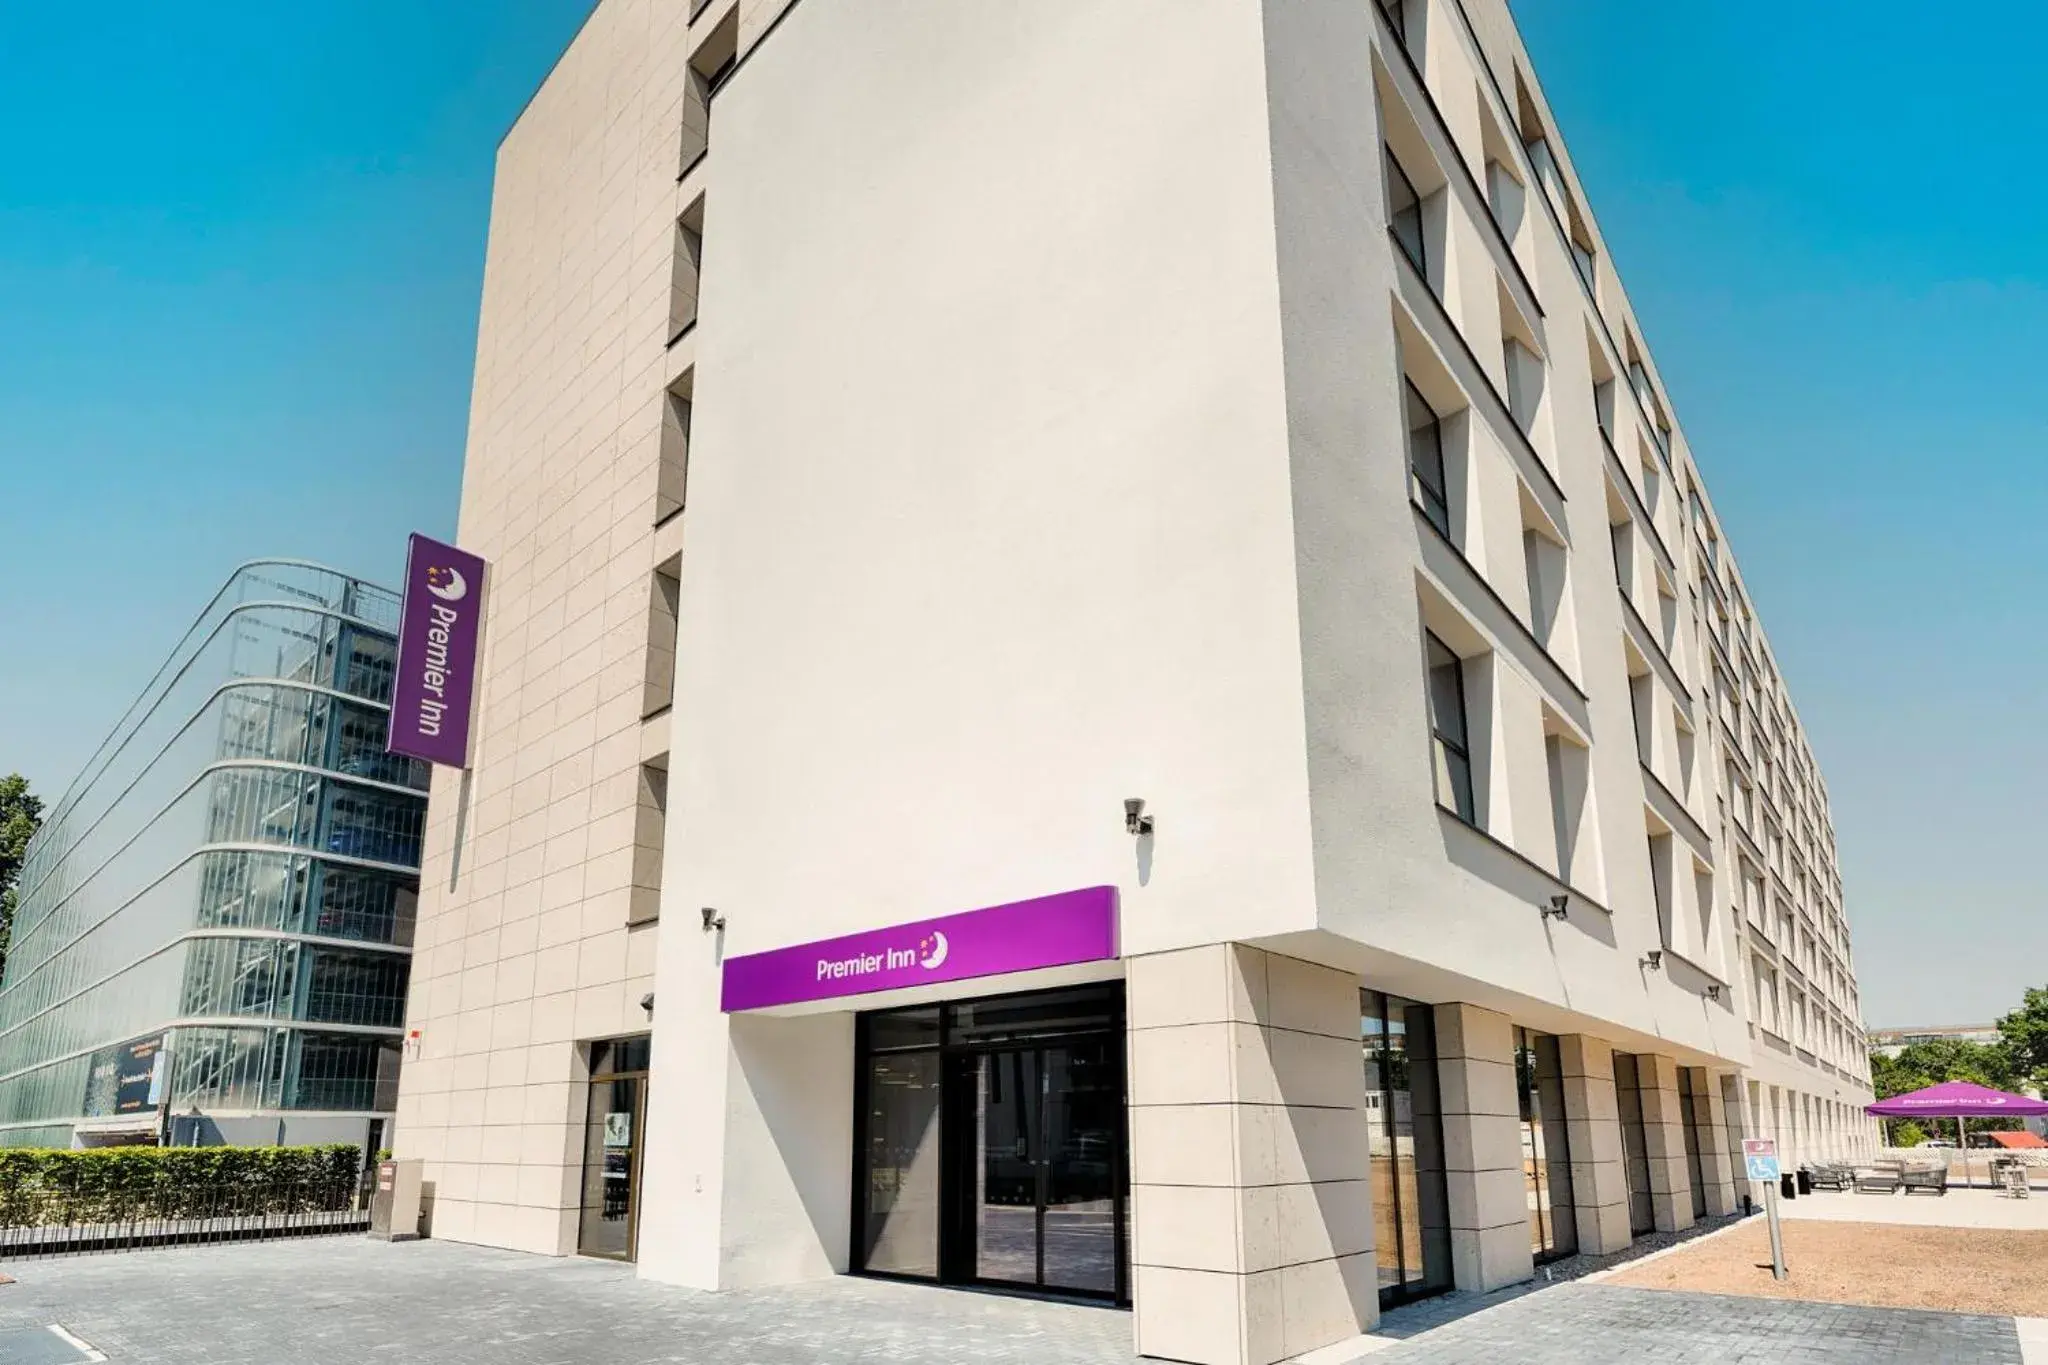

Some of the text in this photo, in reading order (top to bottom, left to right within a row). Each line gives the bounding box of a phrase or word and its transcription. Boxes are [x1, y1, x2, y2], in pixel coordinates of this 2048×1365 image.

[418, 603, 457, 737] Premier Inn
[816, 947, 916, 981] Premier Inn
